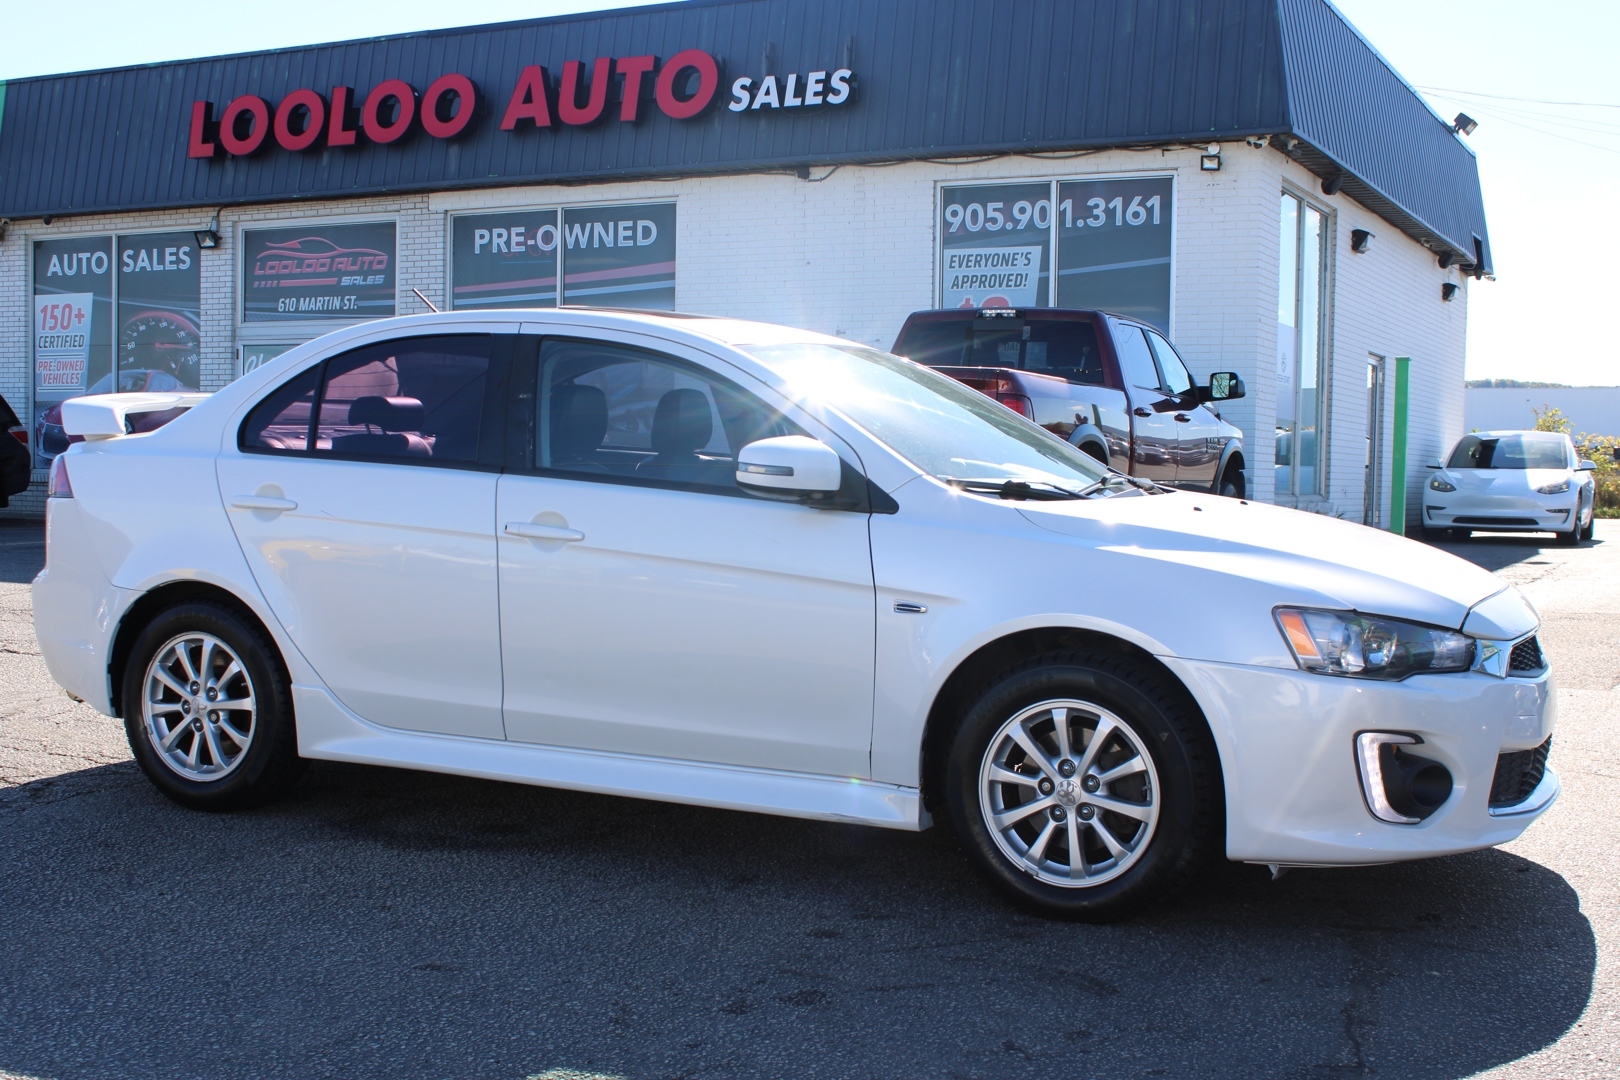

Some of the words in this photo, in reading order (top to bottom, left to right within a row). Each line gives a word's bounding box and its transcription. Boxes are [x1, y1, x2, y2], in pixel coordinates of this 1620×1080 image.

[187, 73, 476, 159] LOOLOO
[499, 48, 718, 131] AUTO
[728, 69, 852, 112] SALES
[945, 195, 1161, 233] 905.901.3161
[474, 220, 658, 254] PRE-OWNED
[47, 251, 109, 277] AUTO
[122, 246, 191, 273] SALES
[254, 258, 331, 275] LOOLOO
[332, 255, 388, 272] AUTO
[949, 251, 1032, 269] EVERYONE'S
[341, 275, 385, 286] SALES
[951, 273, 1029, 290] APPROVED!
[278, 298, 296, 312] 610
[299, 296, 341, 311] MARTIN
[343, 295, 358, 310] ST.
[40, 303, 85, 331] 150+
[38, 334, 85, 349] CERTIFIED
[37, 360, 85, 372] PRE-OWNED
[43, 372, 80, 385] VEHICLES
